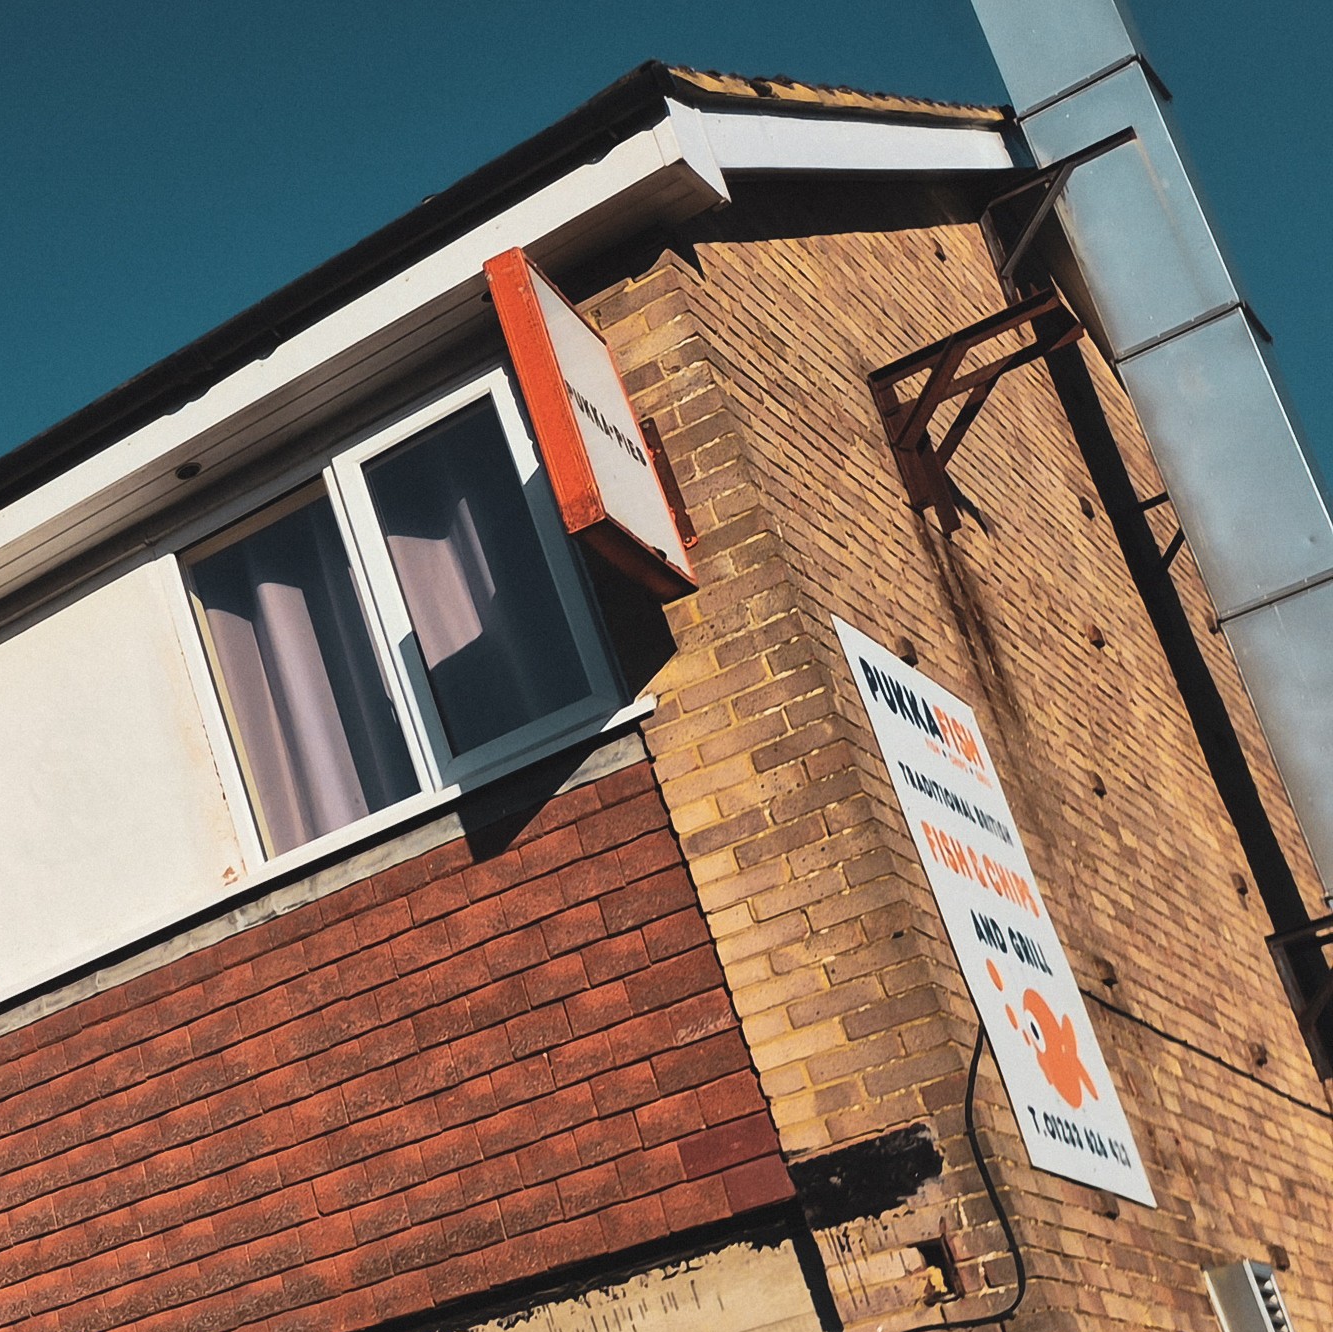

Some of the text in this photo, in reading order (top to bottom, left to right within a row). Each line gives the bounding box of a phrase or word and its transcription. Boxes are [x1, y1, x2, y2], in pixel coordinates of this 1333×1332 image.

[858, 656, 944, 744] PUKKA
[898, 760, 976, 825] TRADITIONAL
[921, 820, 973, 881] FISH
[981, 853, 1040, 919] CHIPS
[970, 909, 1054, 977] AND GRILL
